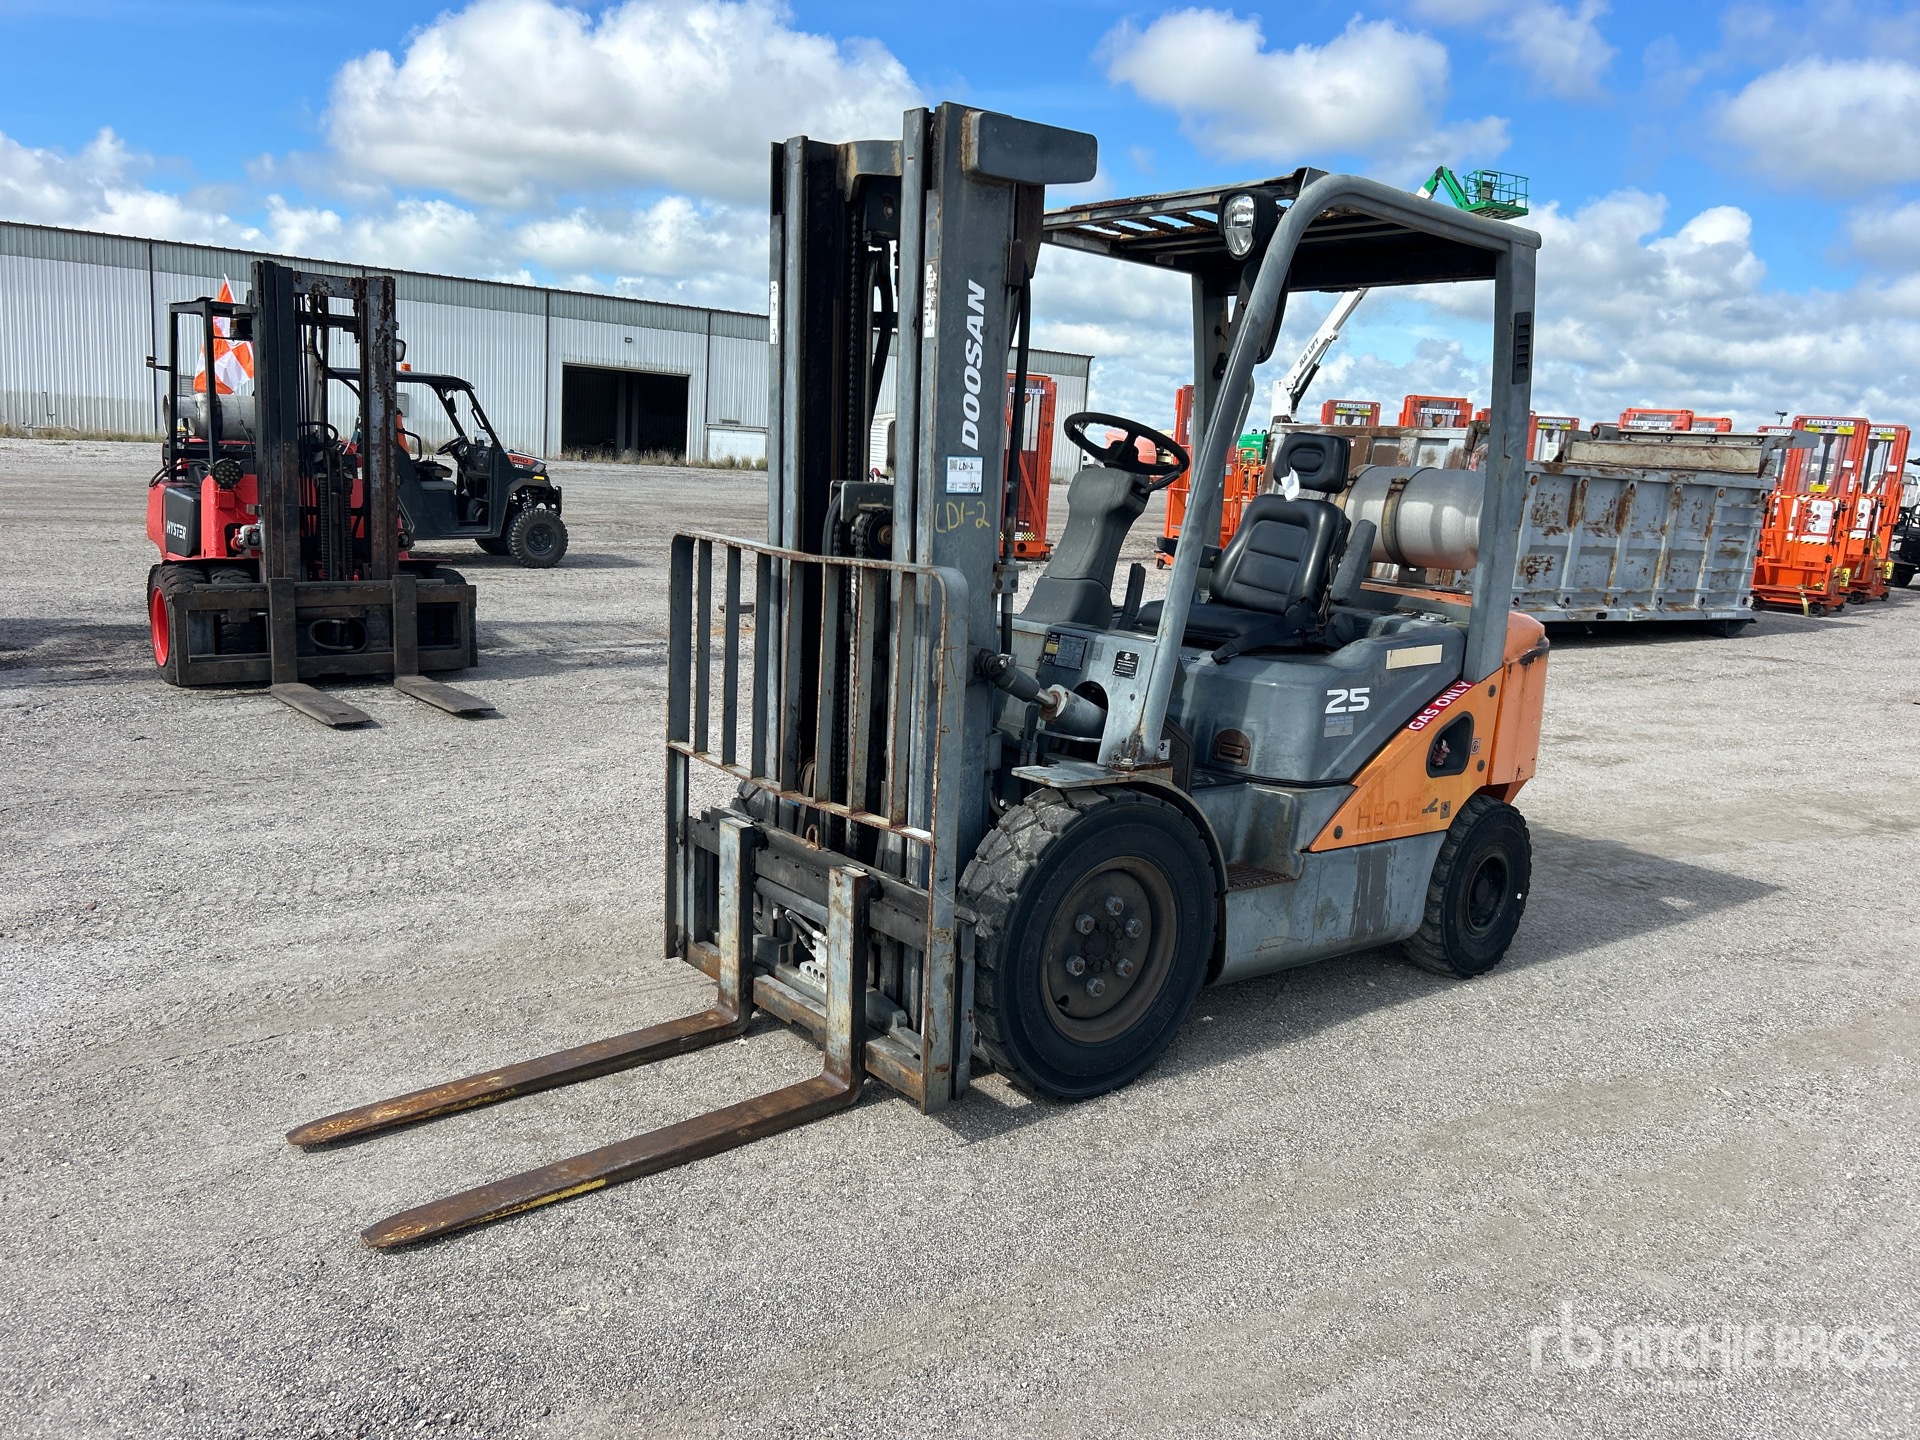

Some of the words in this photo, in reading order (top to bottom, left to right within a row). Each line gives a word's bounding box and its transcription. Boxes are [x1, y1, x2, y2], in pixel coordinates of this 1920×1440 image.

[961, 278, 985, 451] DOOSAN
[167, 520, 187, 540] HYSTER
[1325, 687, 1370, 714] 25
[1408, 707, 1439, 731] GAS
[1435, 681, 1472, 707] ONLY
